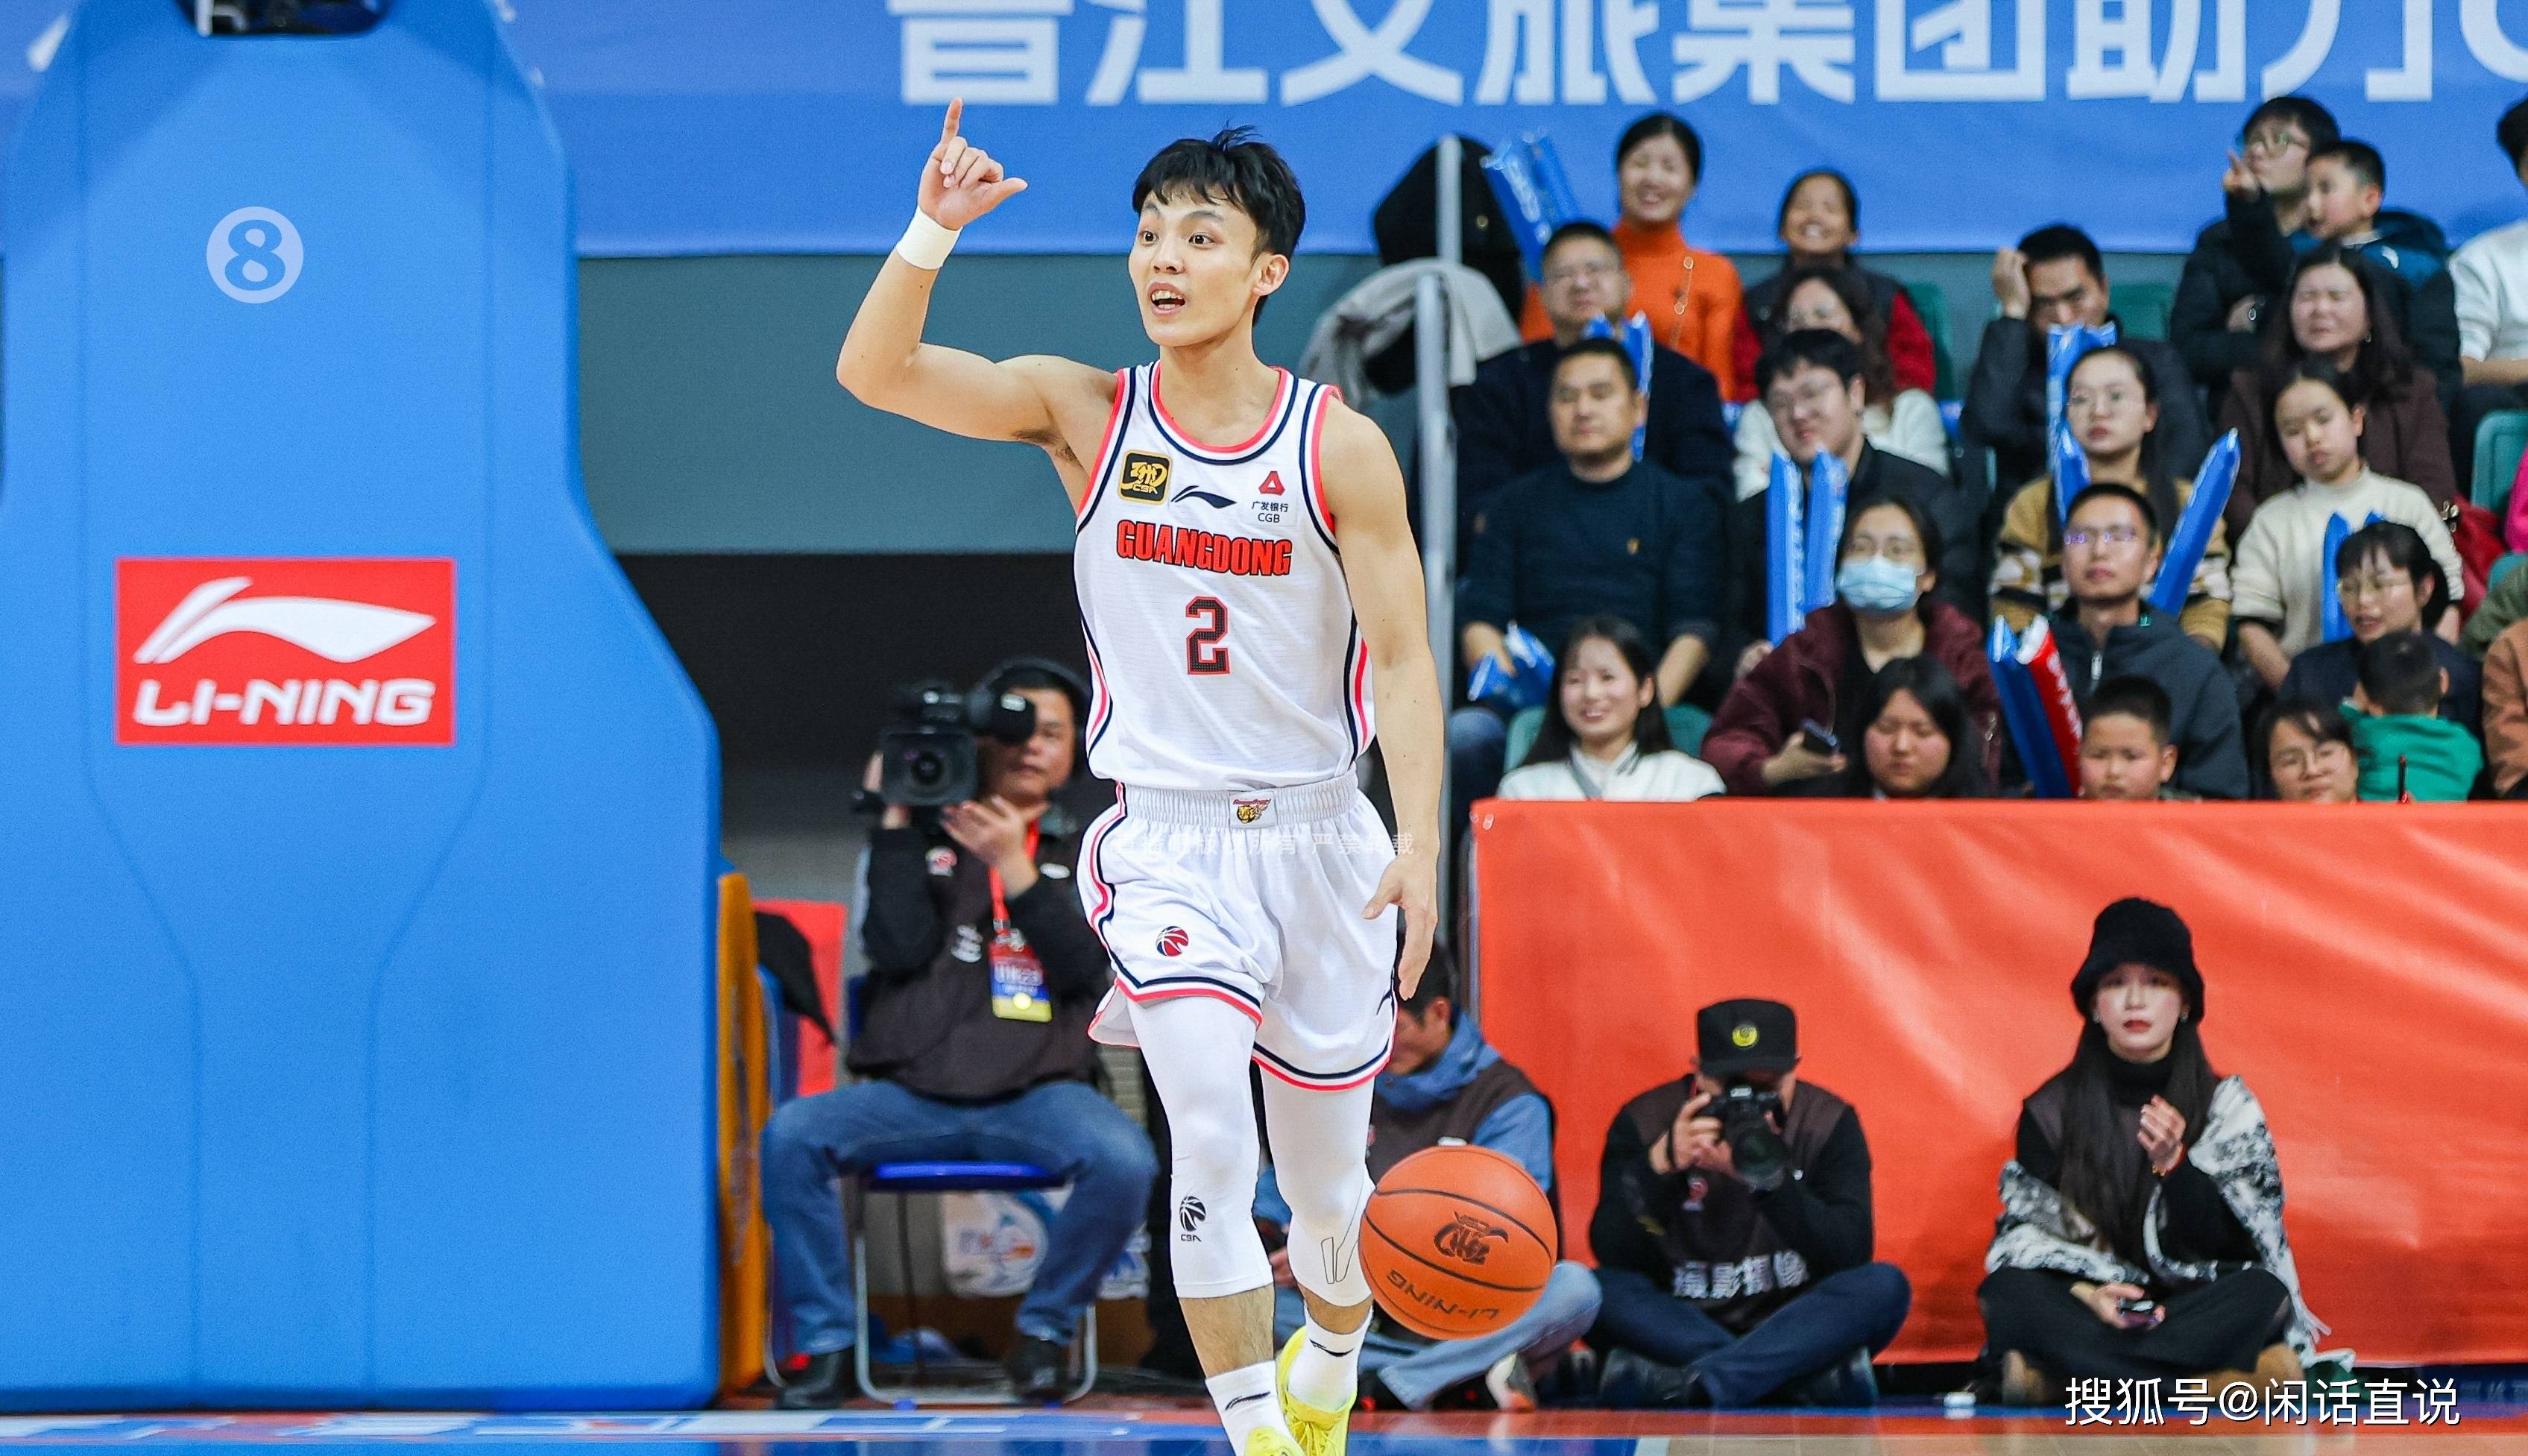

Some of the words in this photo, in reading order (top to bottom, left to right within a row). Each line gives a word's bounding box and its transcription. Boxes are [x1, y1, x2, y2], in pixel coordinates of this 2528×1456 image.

[887, 0, 2528, 106] 晋江文旅集团助力
[224, 219, 286, 291] 8
[1132, 483, 1159, 495] CBA
[1251, 500, 1289, 513] 广发银行
[1258, 512, 1281, 523] CGB
[1116, 519, 1293, 577] GUANGDONG
[1185, 596, 1231, 675] 2
[132, 678, 436, 726] LI-NING
[1180, 1233, 1202, 1243] CBA
[1386, 1268, 1500, 1320] LI-NING
